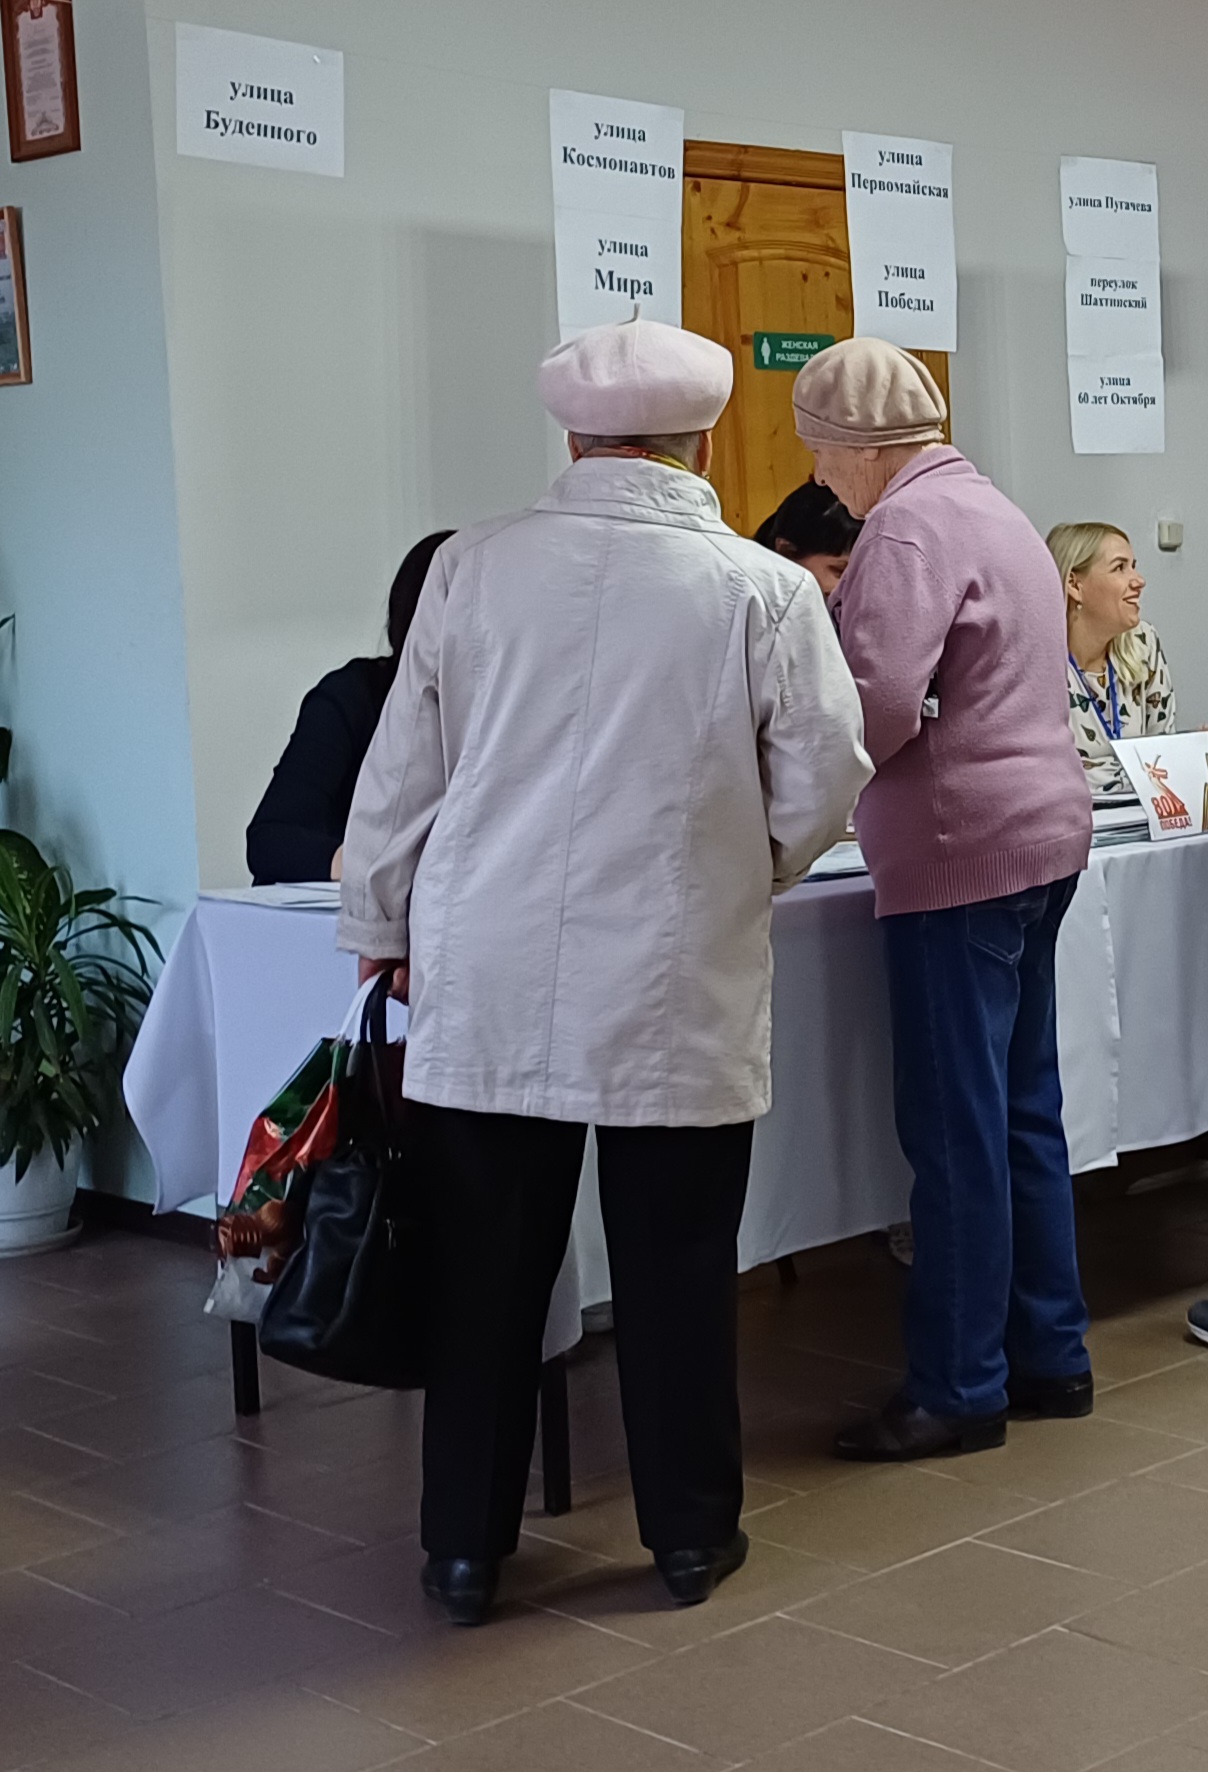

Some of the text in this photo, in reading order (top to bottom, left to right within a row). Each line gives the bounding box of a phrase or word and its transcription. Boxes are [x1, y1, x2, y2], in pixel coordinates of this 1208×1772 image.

[229, 80, 294, 106] улица
[204, 109, 317, 145] Буденного
[593, 122, 646, 143] улица
[562, 146, 675, 180] Космонавтов
[878, 150, 923, 167] улица
[851, 172, 949, 199] Первомайская
[1068, 196, 1152, 213] улица Пугачева
[598, 238, 649, 258] улица
[884, 264, 925, 280] улица
[594, 268, 654, 300] Мира
[1090, 278, 1138, 292] переулок
[878, 290, 934, 312] Победы
[1080, 293, 1147, 309] Шахтинский
[1099, 376, 1131, 389] улица
[1077, 391, 1156, 409] 60 лет Октября
